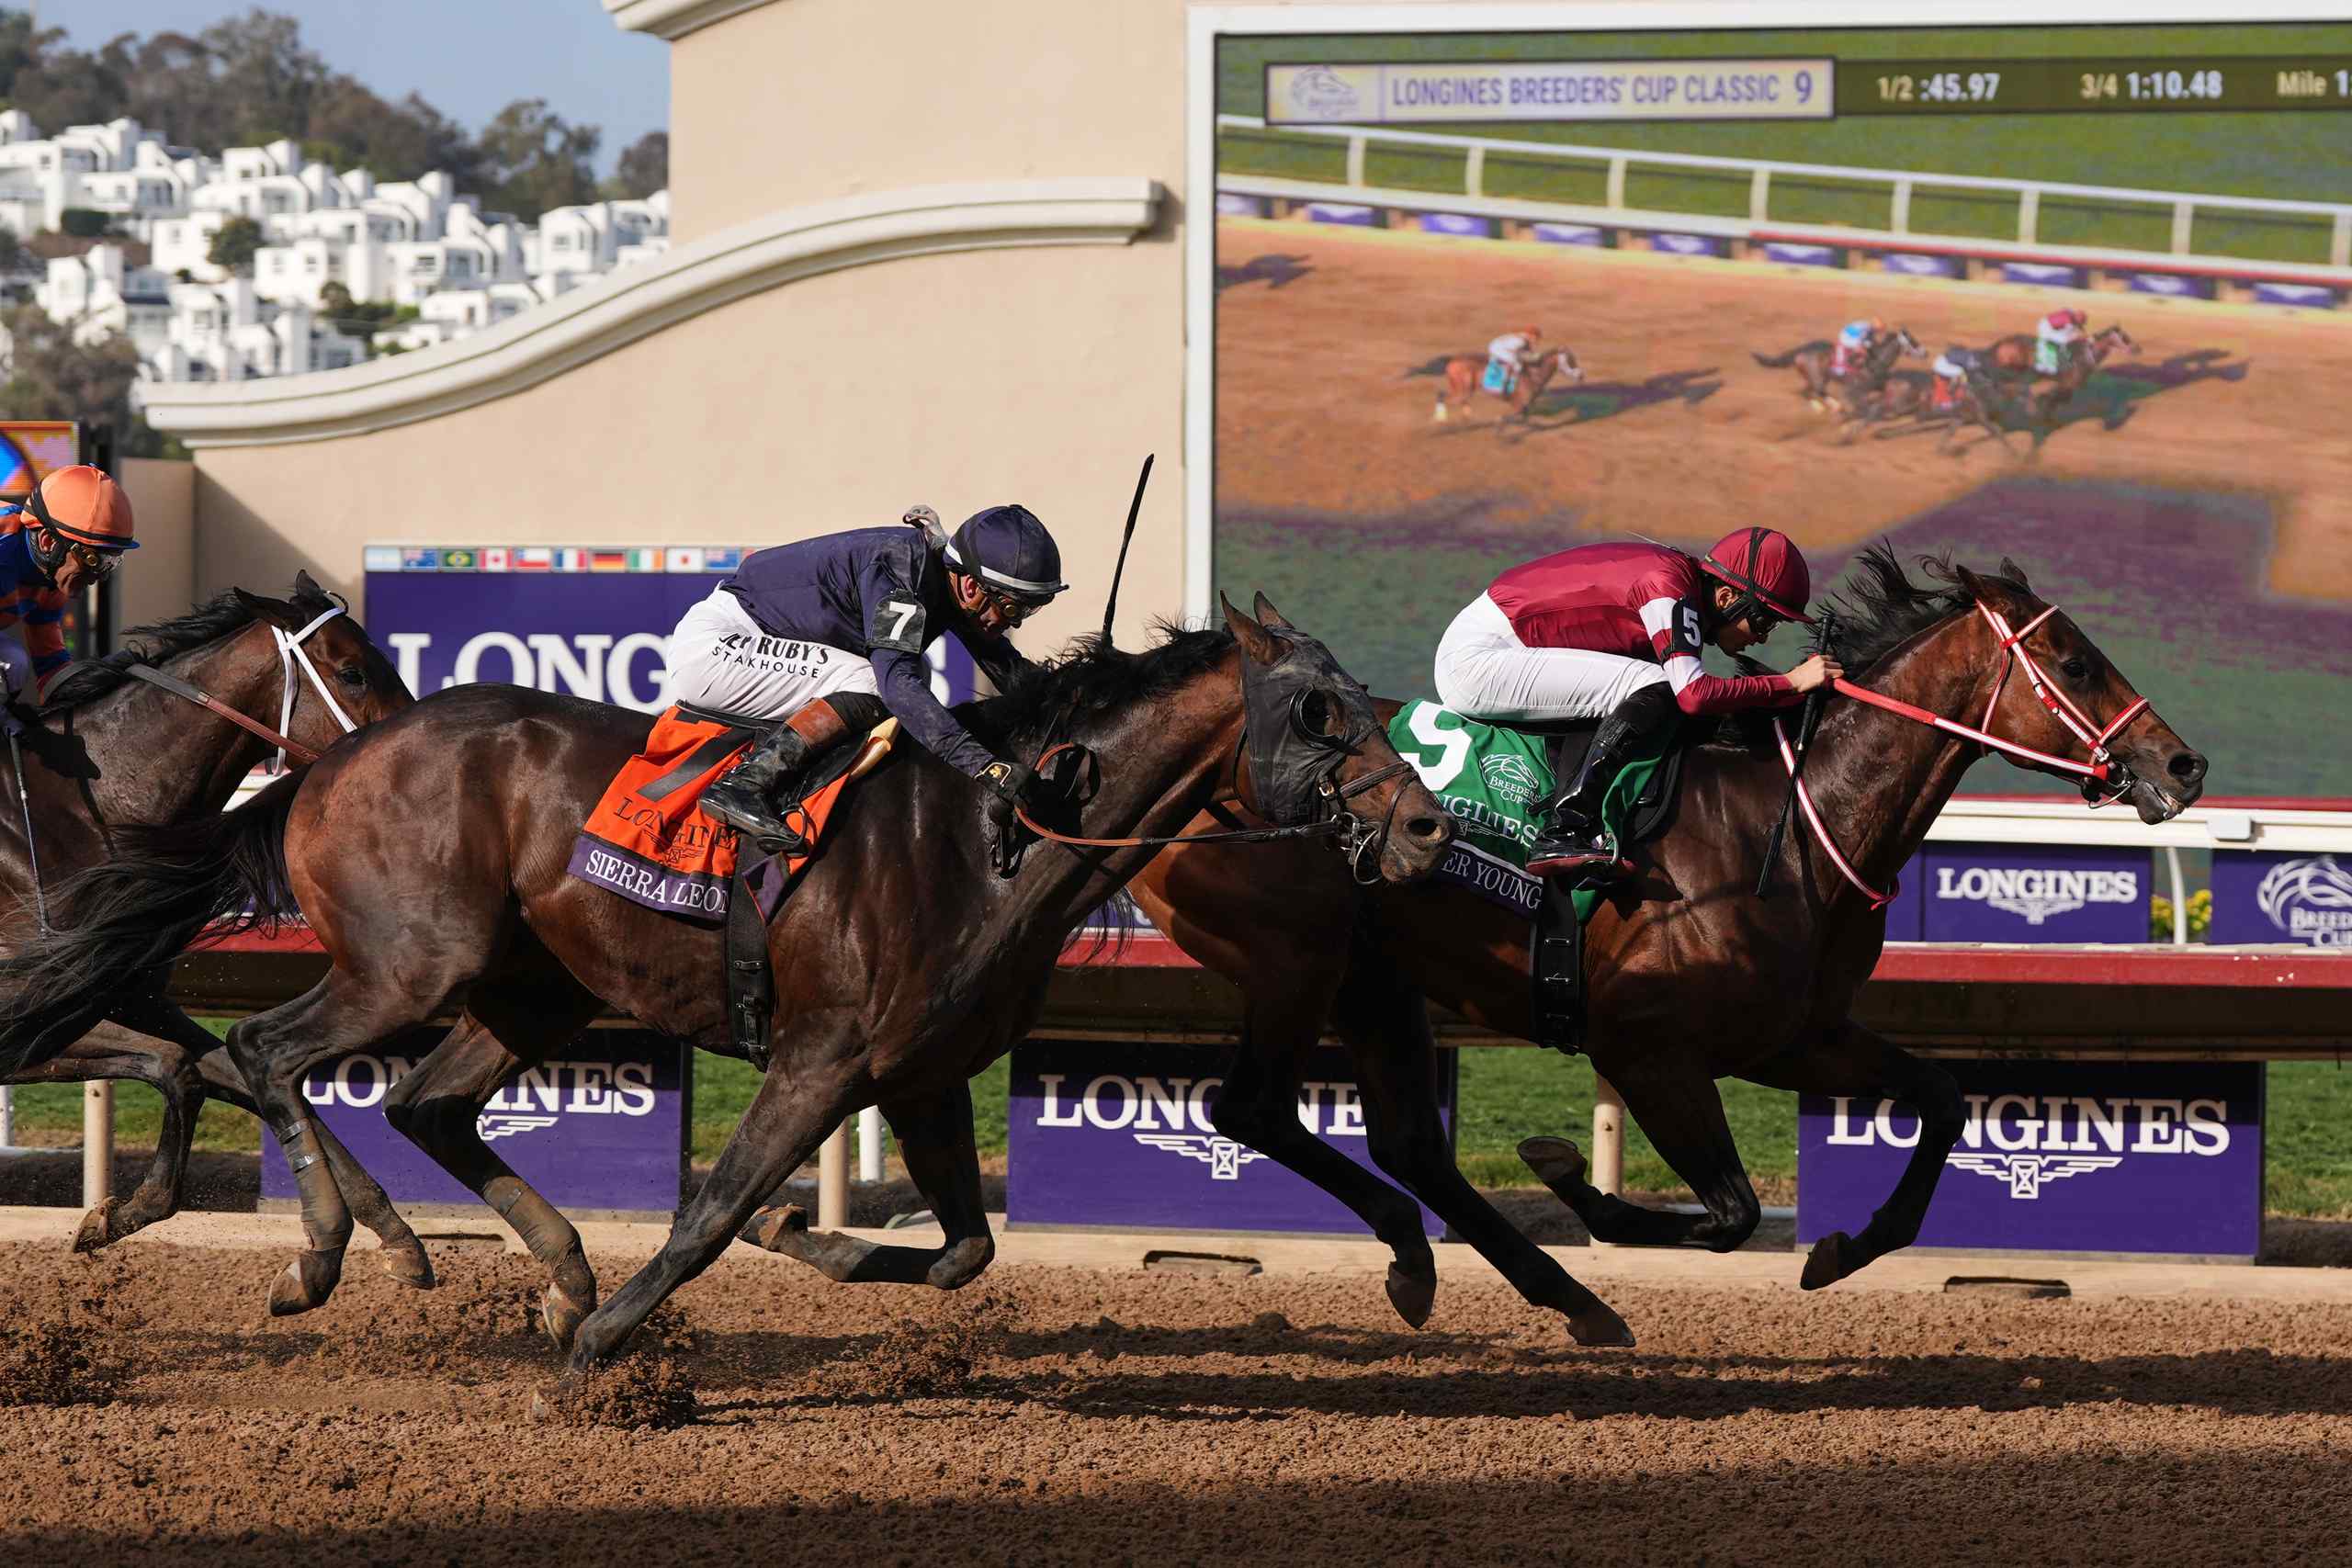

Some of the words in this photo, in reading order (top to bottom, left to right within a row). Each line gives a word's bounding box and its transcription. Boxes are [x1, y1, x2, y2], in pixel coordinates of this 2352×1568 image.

[1392, 77, 1503, 107] LONGINES
[1510, 73, 1627, 105] BREEDERS'
[1633, 76, 1678, 104] CUP
[1684, 74, 1781, 103] CLASSIC
[1793, 70, 1813, 104] 9
[1877, 75, 1914, 102] 1/2
[1919, 73, 2000, 102] :45.97
[2080, 73, 2118, 99] 3/4
[2128, 71, 2223, 100] 1:10.48
[2277, 70, 2327, 97] Mile
[889, 601, 917, 641] 7
[1682, 605, 1702, 648] 5
[756, 636, 831, 665] RUBY'S
[1499, 788, 1524, 804] CUP
[584, 849, 667, 904] SIERRA
[671, 882, 731, 914] LEON
[1473, 862, 1544, 910] YOUNG
[1937, 867, 2139, 904] LONGINES
